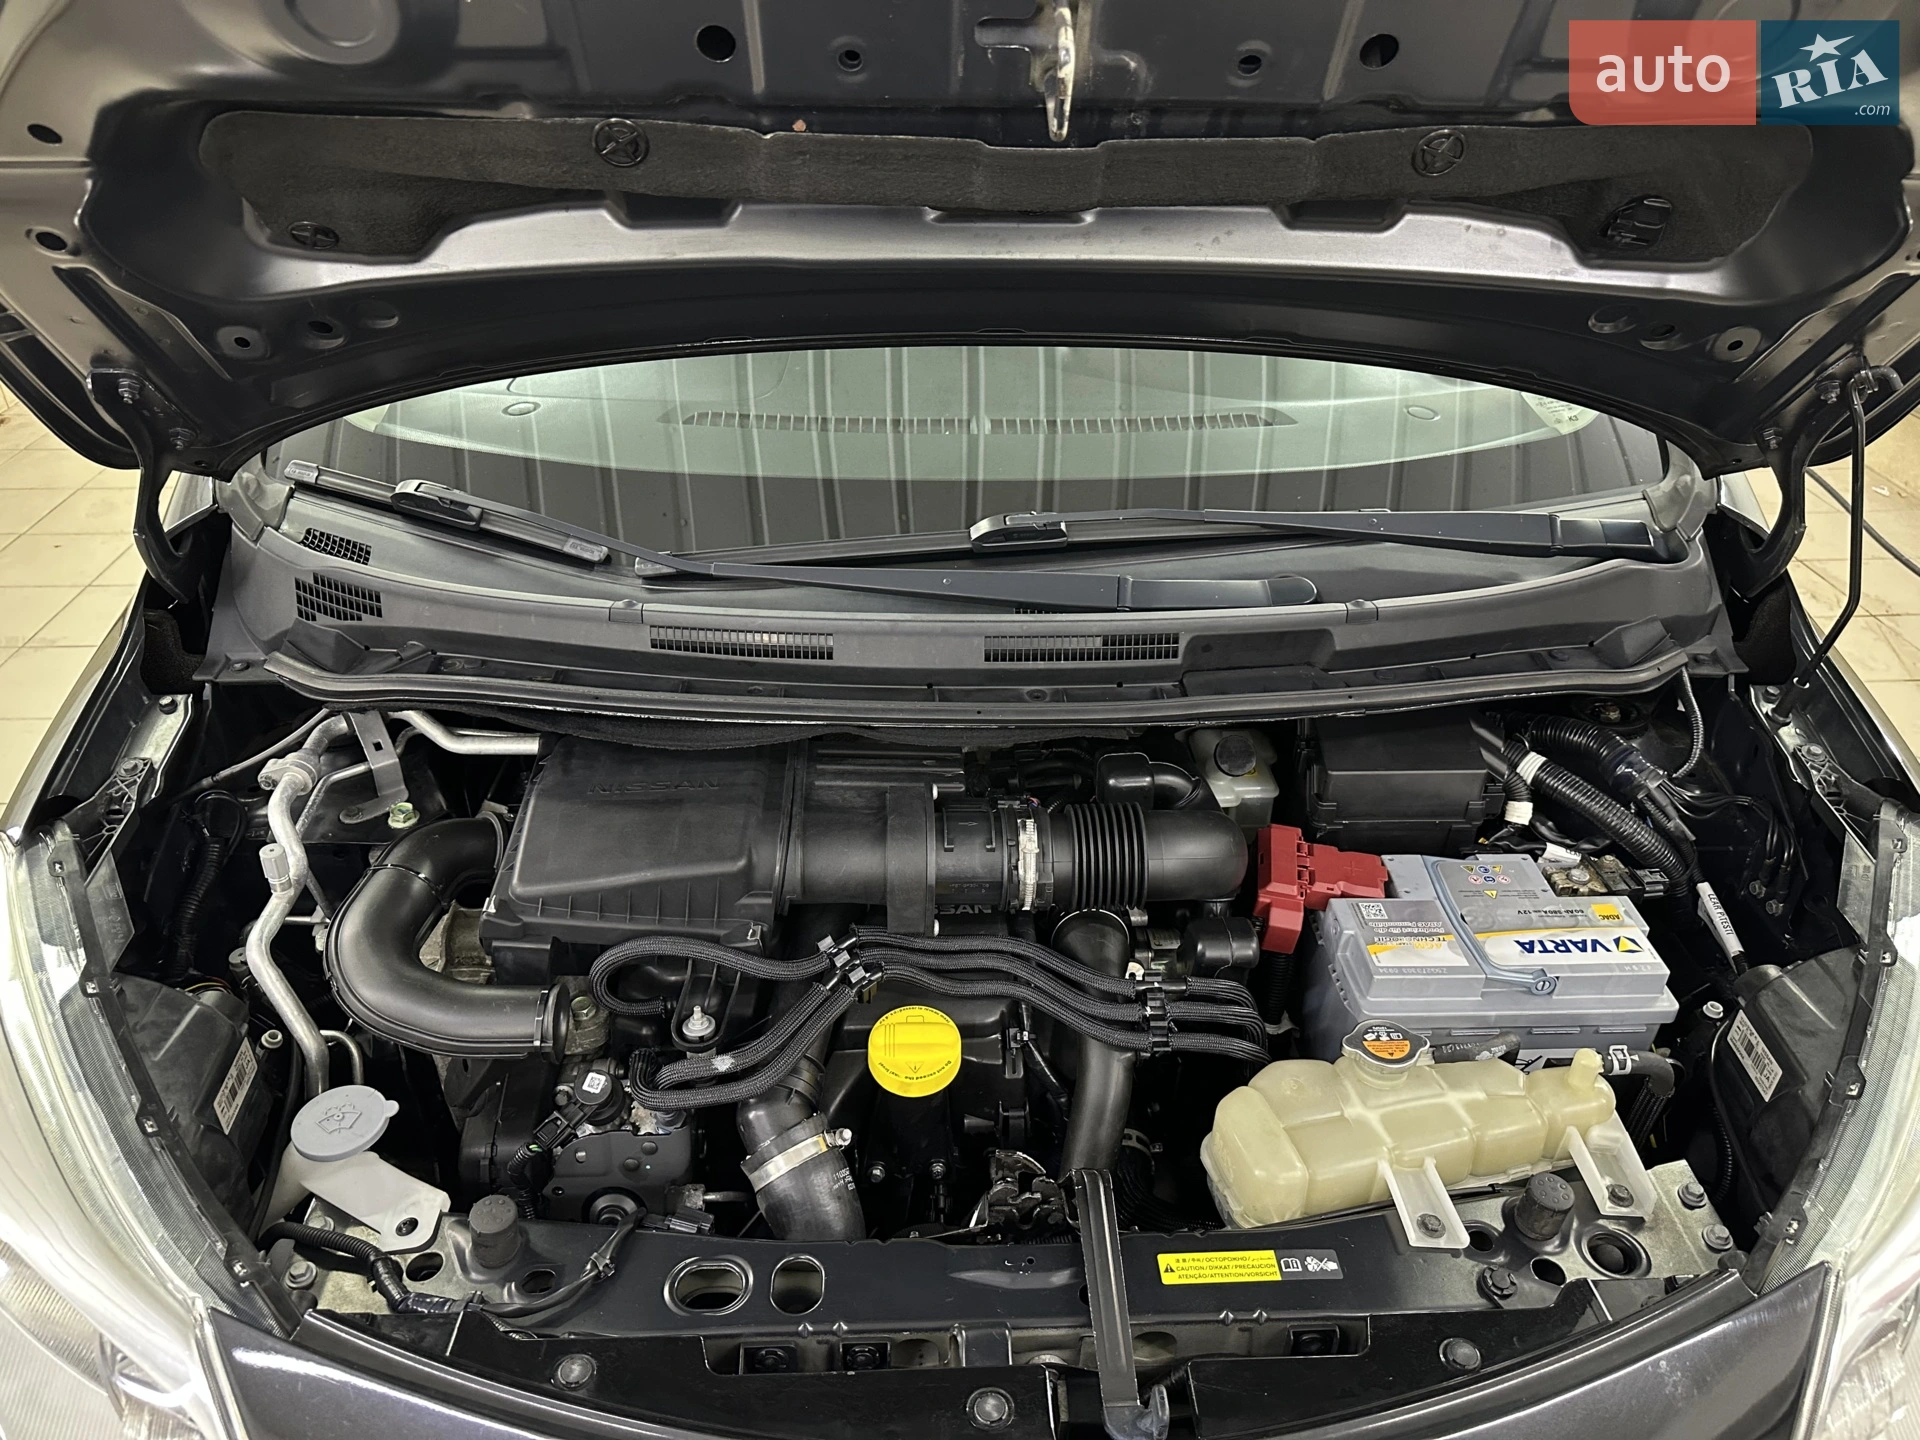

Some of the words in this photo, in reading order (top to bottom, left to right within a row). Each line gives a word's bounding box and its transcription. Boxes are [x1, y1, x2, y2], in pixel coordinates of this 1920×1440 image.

[587, 776, 720, 795] NISSAN
[1708, 893, 1722, 910] LEAR
[1513, 939, 1612, 954] VARTA
